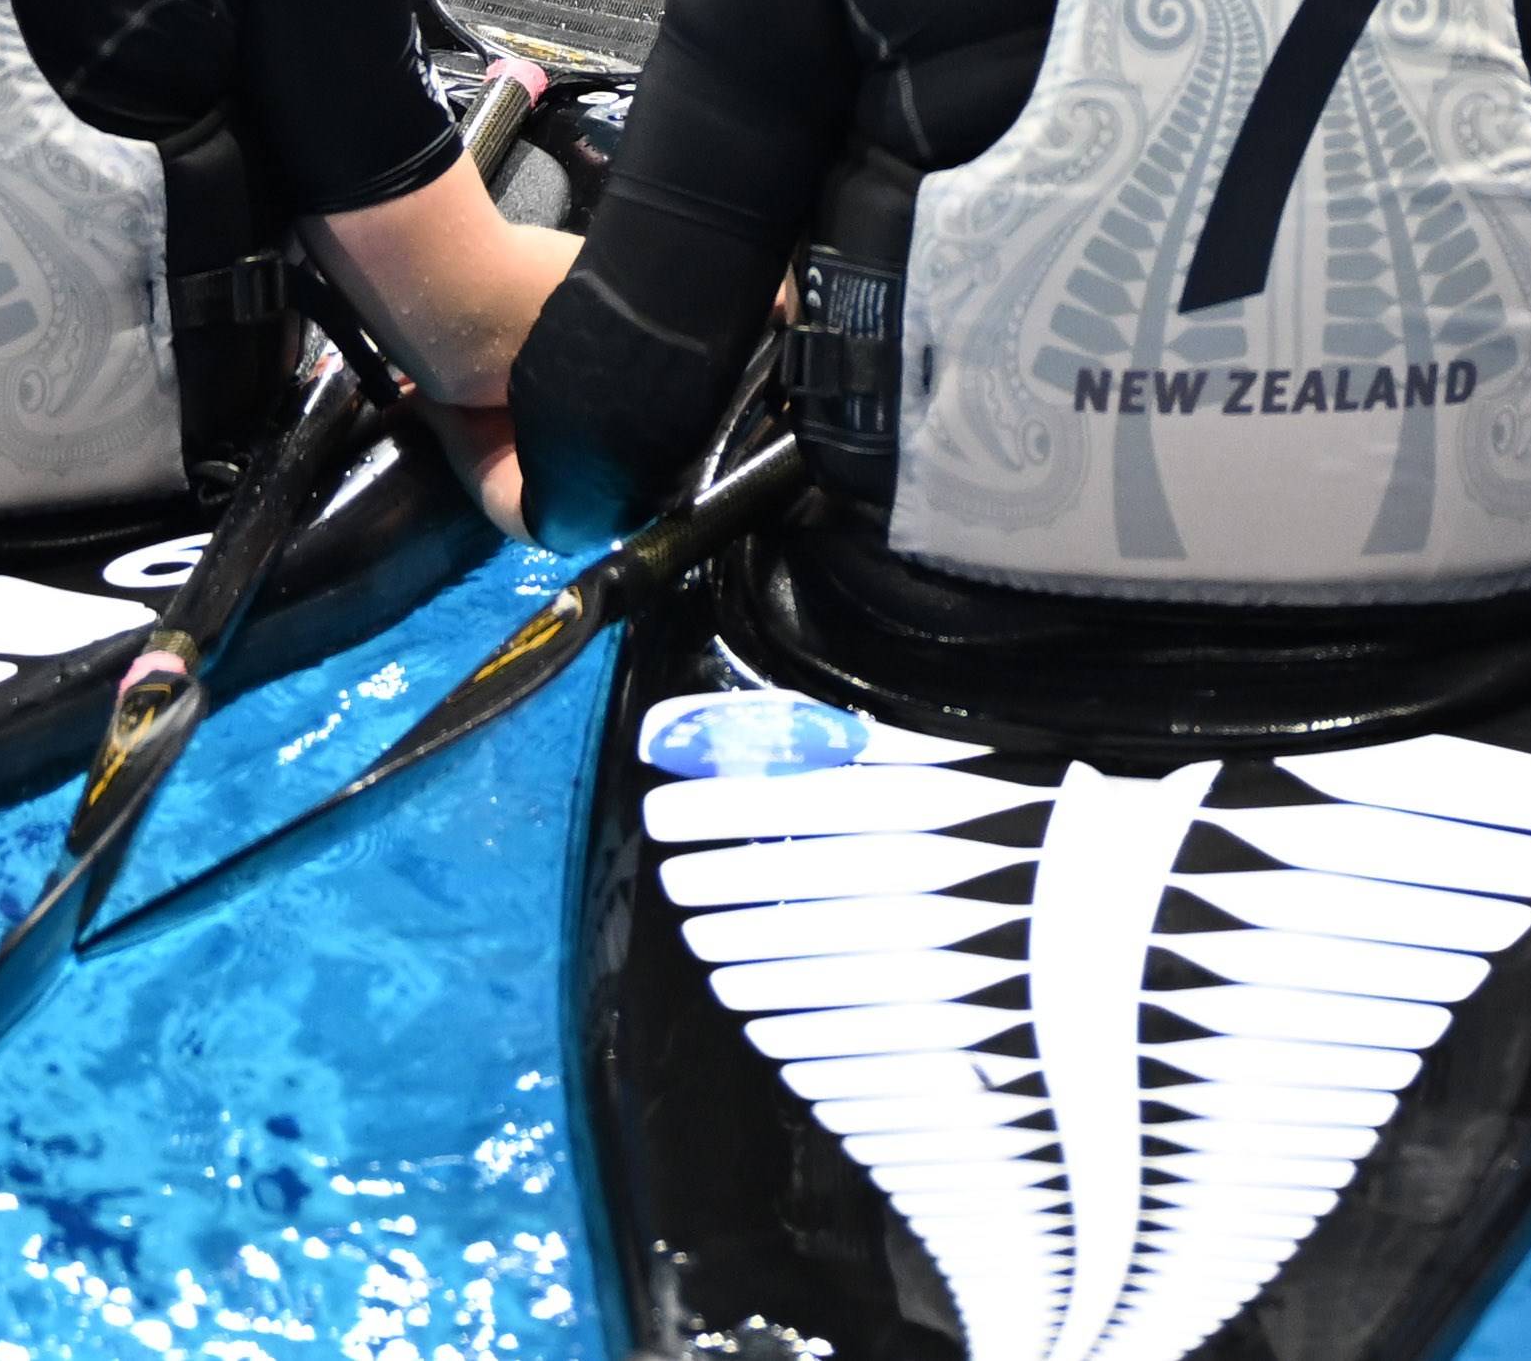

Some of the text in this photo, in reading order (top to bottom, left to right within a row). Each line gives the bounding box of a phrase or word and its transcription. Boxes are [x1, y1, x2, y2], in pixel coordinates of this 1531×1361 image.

[1072, 359, 1478, 416] NEW ZEALAND
[103, 532, 214, 587] 6
